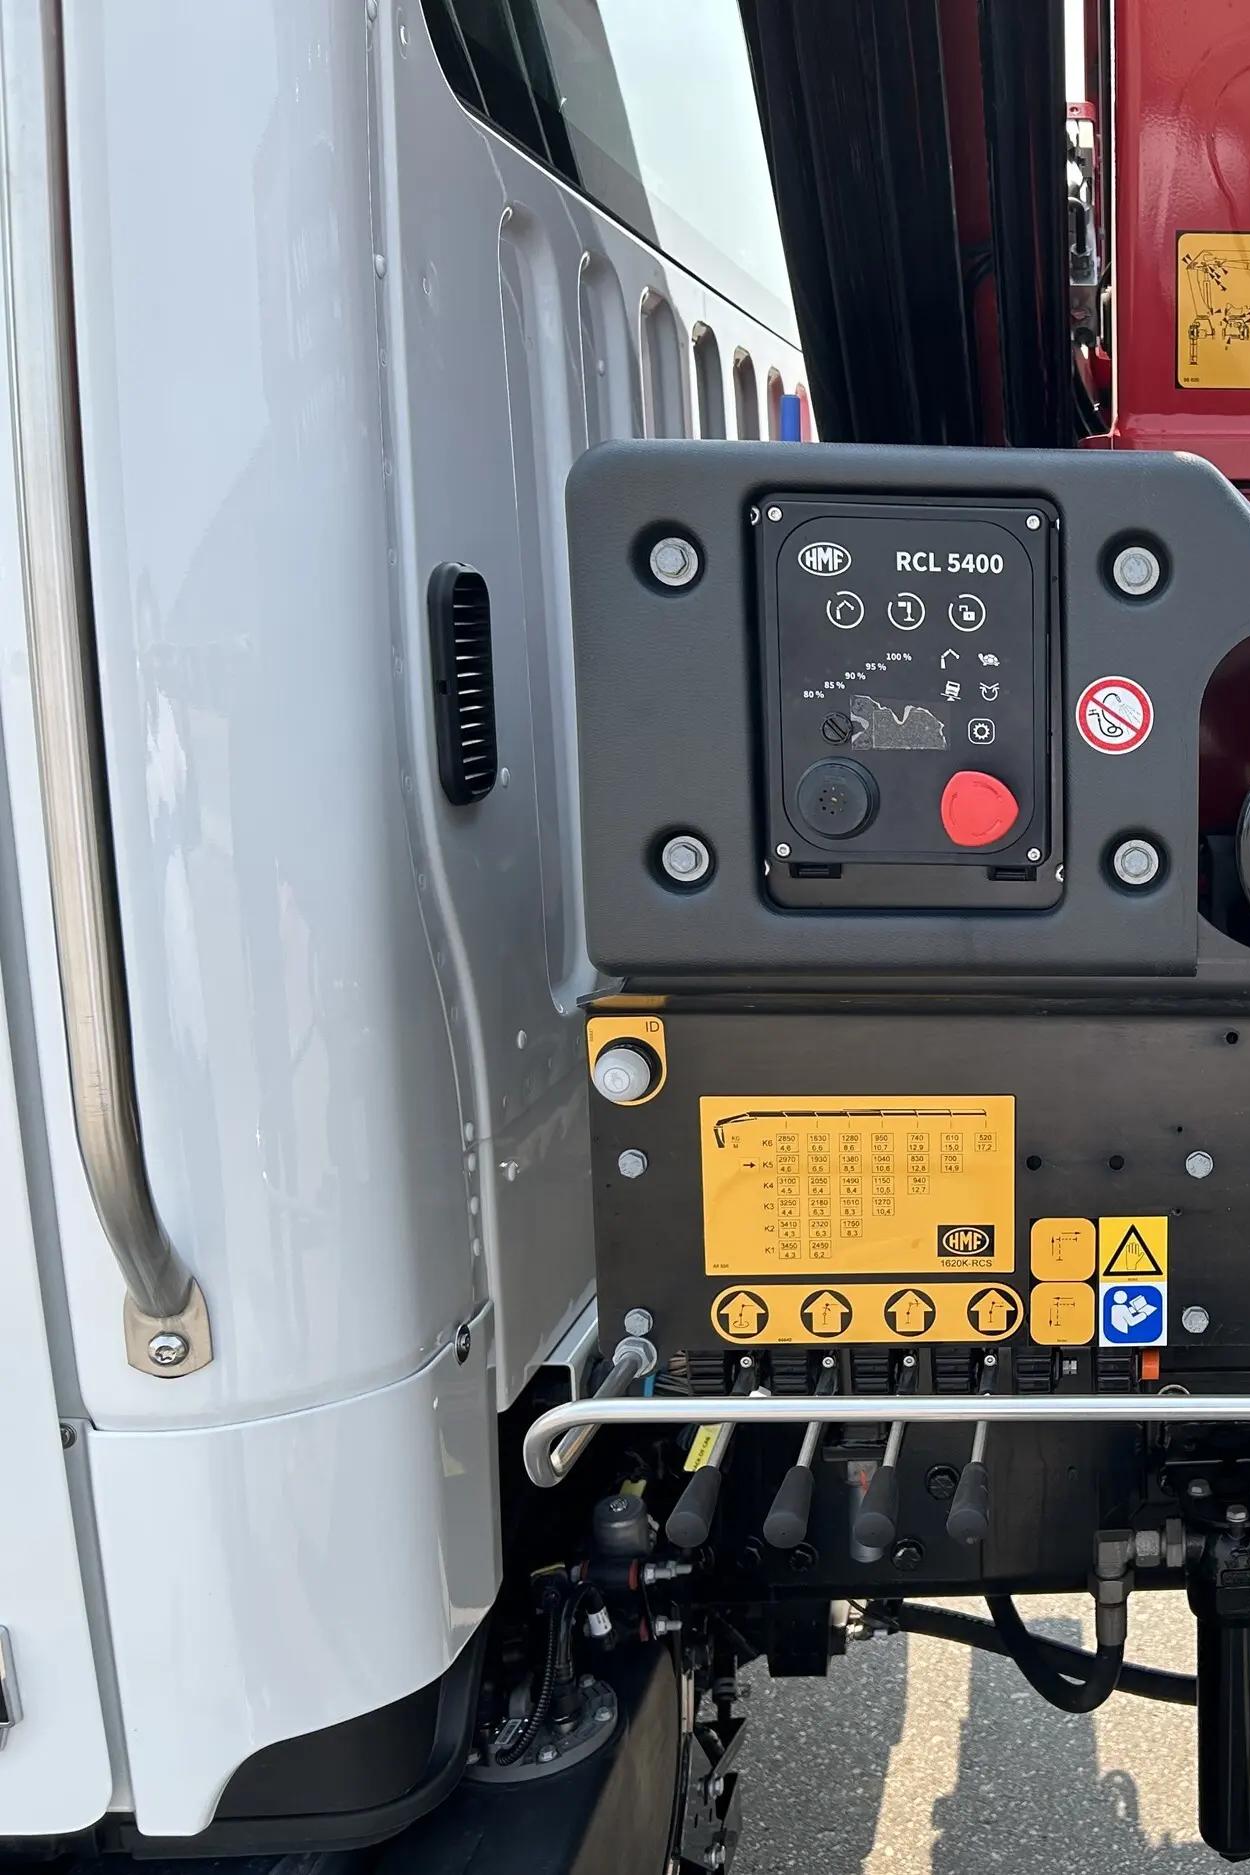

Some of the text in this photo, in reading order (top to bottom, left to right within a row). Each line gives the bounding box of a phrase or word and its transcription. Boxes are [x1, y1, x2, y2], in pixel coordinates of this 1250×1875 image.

[805, 547, 844, 572] HMF
[896, 552, 1004, 574] RCL 5400
[903, 653, 912, 661] %
[878, 663, 887, 671] %
[857, 672, 866, 680] %
[836, 681, 845, 689] %
[815, 690, 825, 698] %
[645, 1021, 660, 1032] ID
[949, 1231, 982, 1251] HMF
